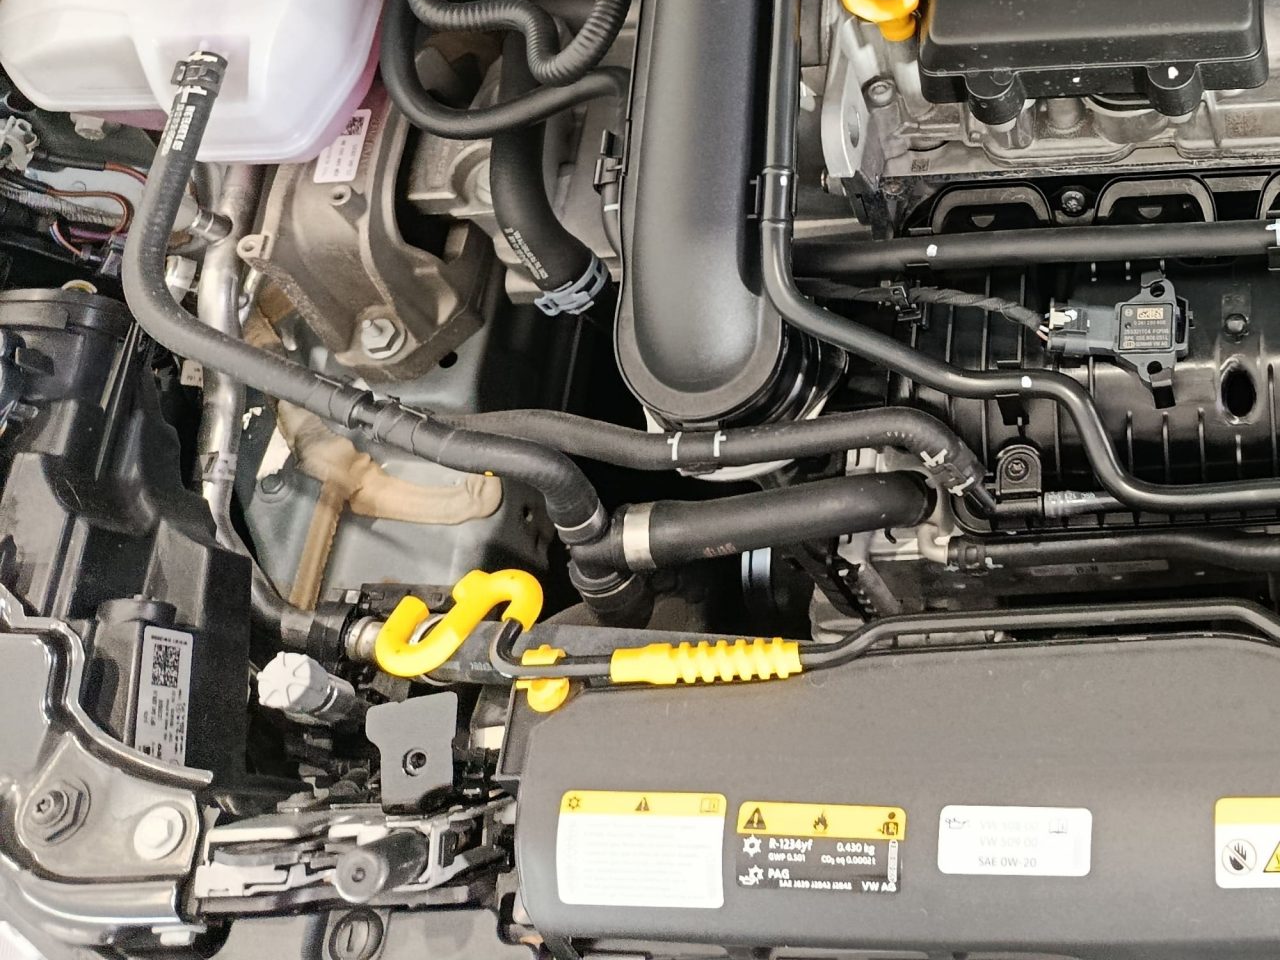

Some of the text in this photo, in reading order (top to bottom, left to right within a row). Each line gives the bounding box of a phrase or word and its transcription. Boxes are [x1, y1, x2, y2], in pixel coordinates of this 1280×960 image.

[769, 838, 876, 856] R-1234yf 0.430 kg
[979, 836, 1039, 849] VW 509 00
[768, 852, 786, 862] GWP
[978, 856, 1038, 868] SAE 0W-20
[768, 867, 790, 879] PAG
[861, 879, 897, 893] VW AG
